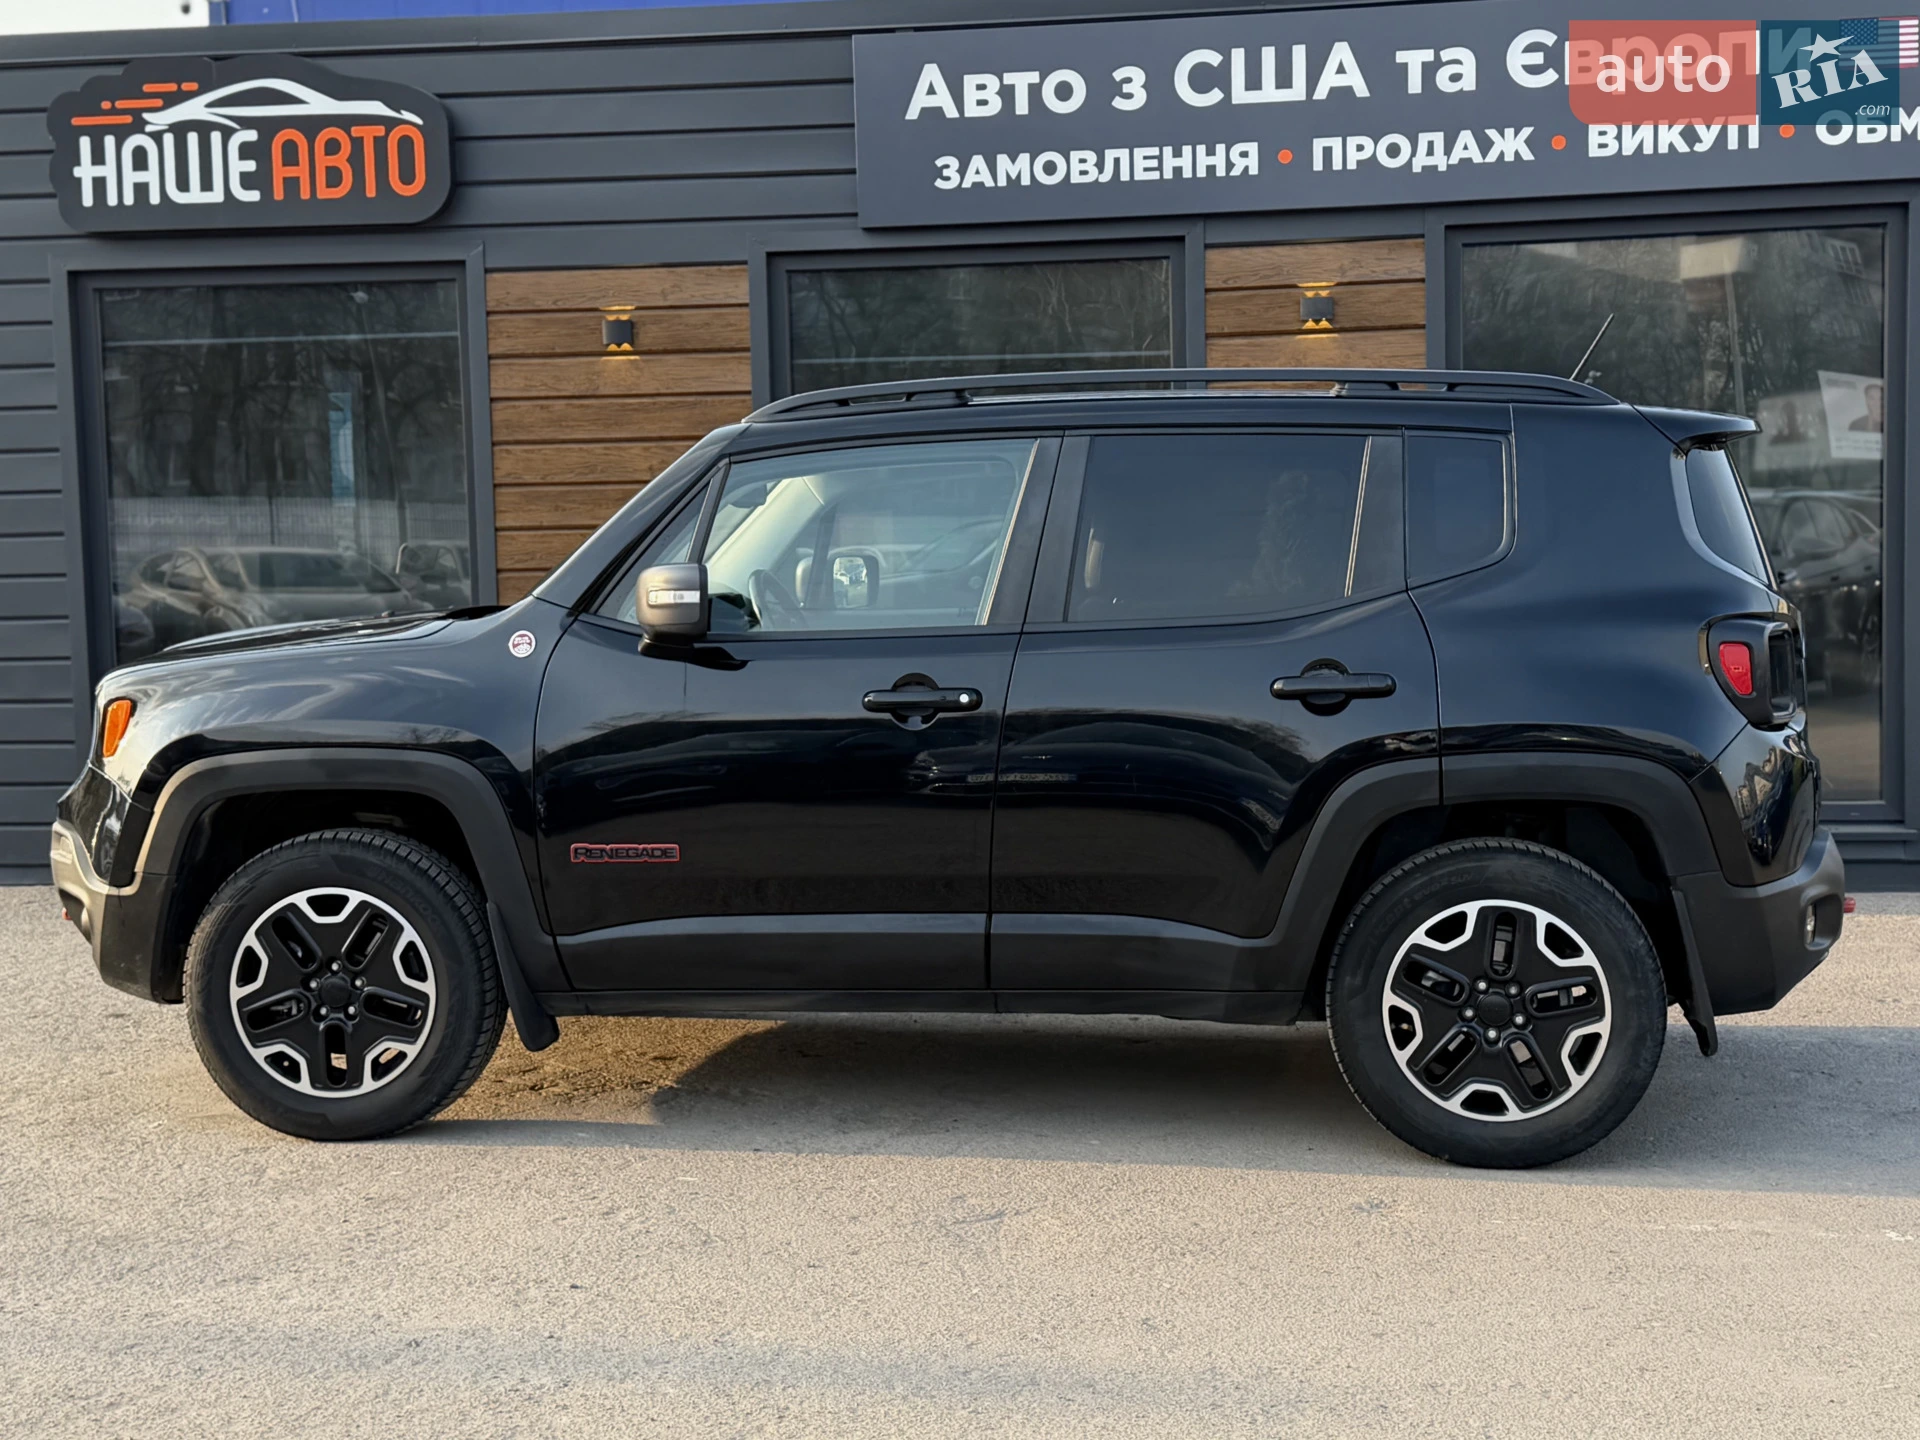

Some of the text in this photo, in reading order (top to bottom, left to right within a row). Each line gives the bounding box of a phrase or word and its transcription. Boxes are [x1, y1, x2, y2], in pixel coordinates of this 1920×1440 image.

[905, 63, 1087, 119] Авто
[1174, 41, 1371, 107] США
[1395, 45, 1477, 94] та
[73, 124, 427, 207] НАШЕ АВТО
[934, 142, 1259, 190] ЗАМОВЛЕННЯ
[1312, 127, 1536, 172] ПРОДАЖ
[1587, 114, 1760, 158] ВИКУП
[572, 845, 678, 860] RENEGADE
